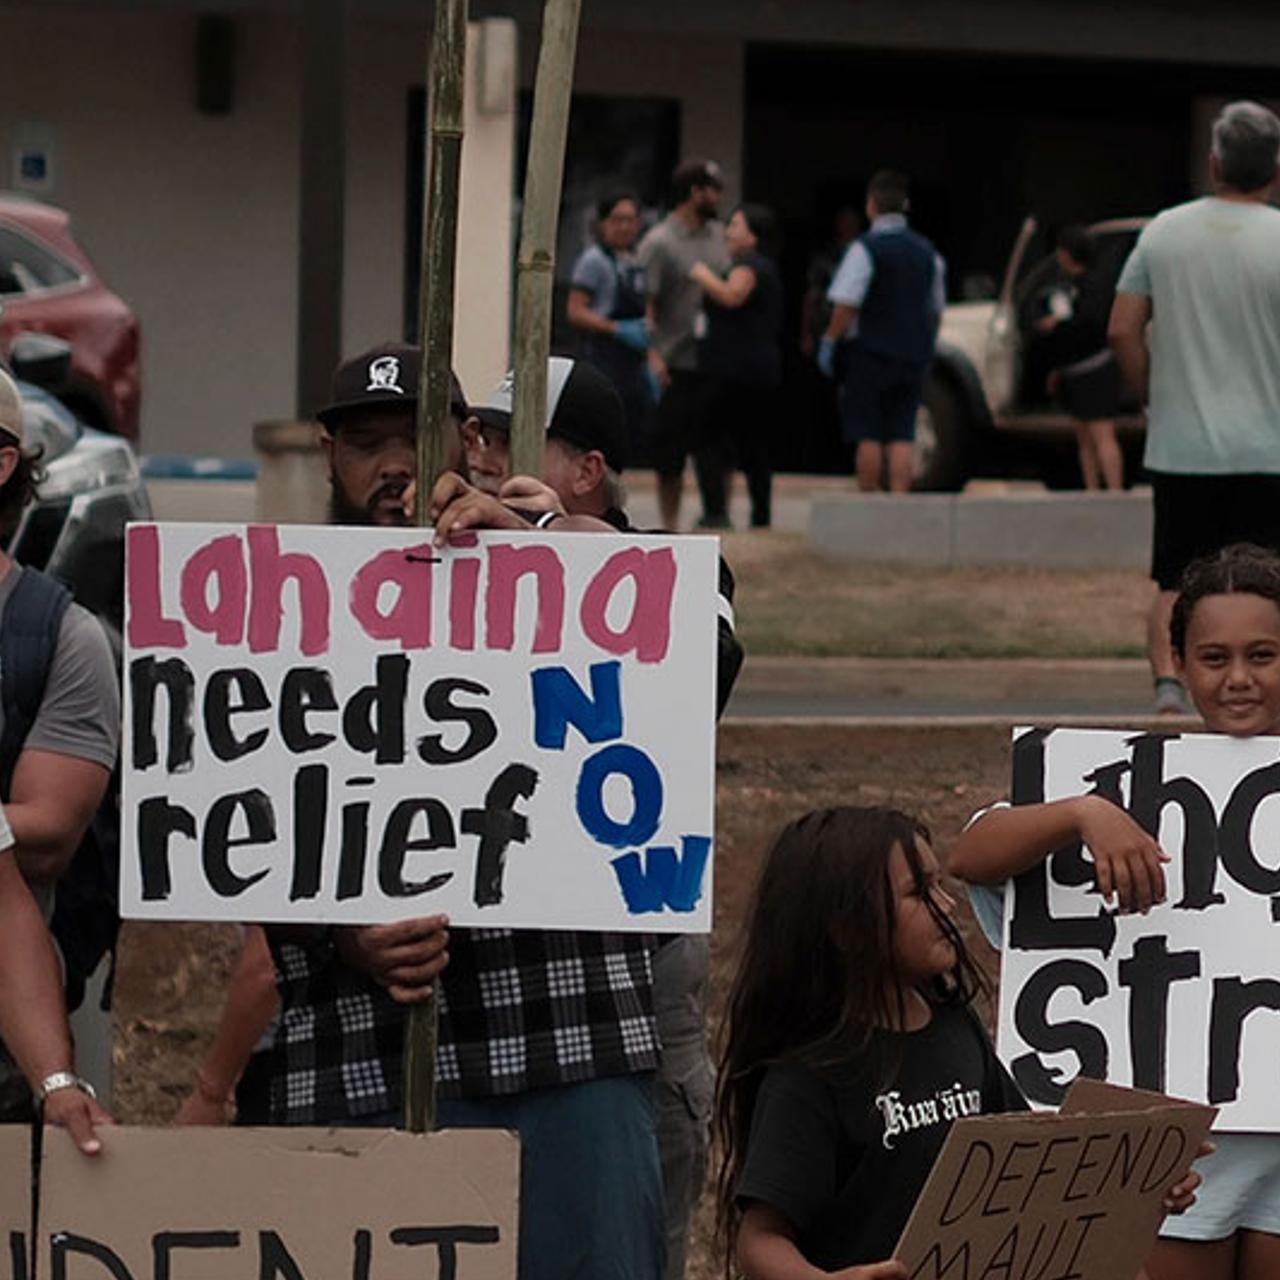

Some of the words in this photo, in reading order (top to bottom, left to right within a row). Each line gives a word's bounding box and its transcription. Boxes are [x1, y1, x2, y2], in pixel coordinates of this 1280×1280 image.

[126, 523, 678, 664] Lahaina
[131, 653, 498, 775] needs
[531, 660, 711, 914] NOW
[138, 762, 540, 907] relief
[939, 1124, 1187, 1227] DEFEND
